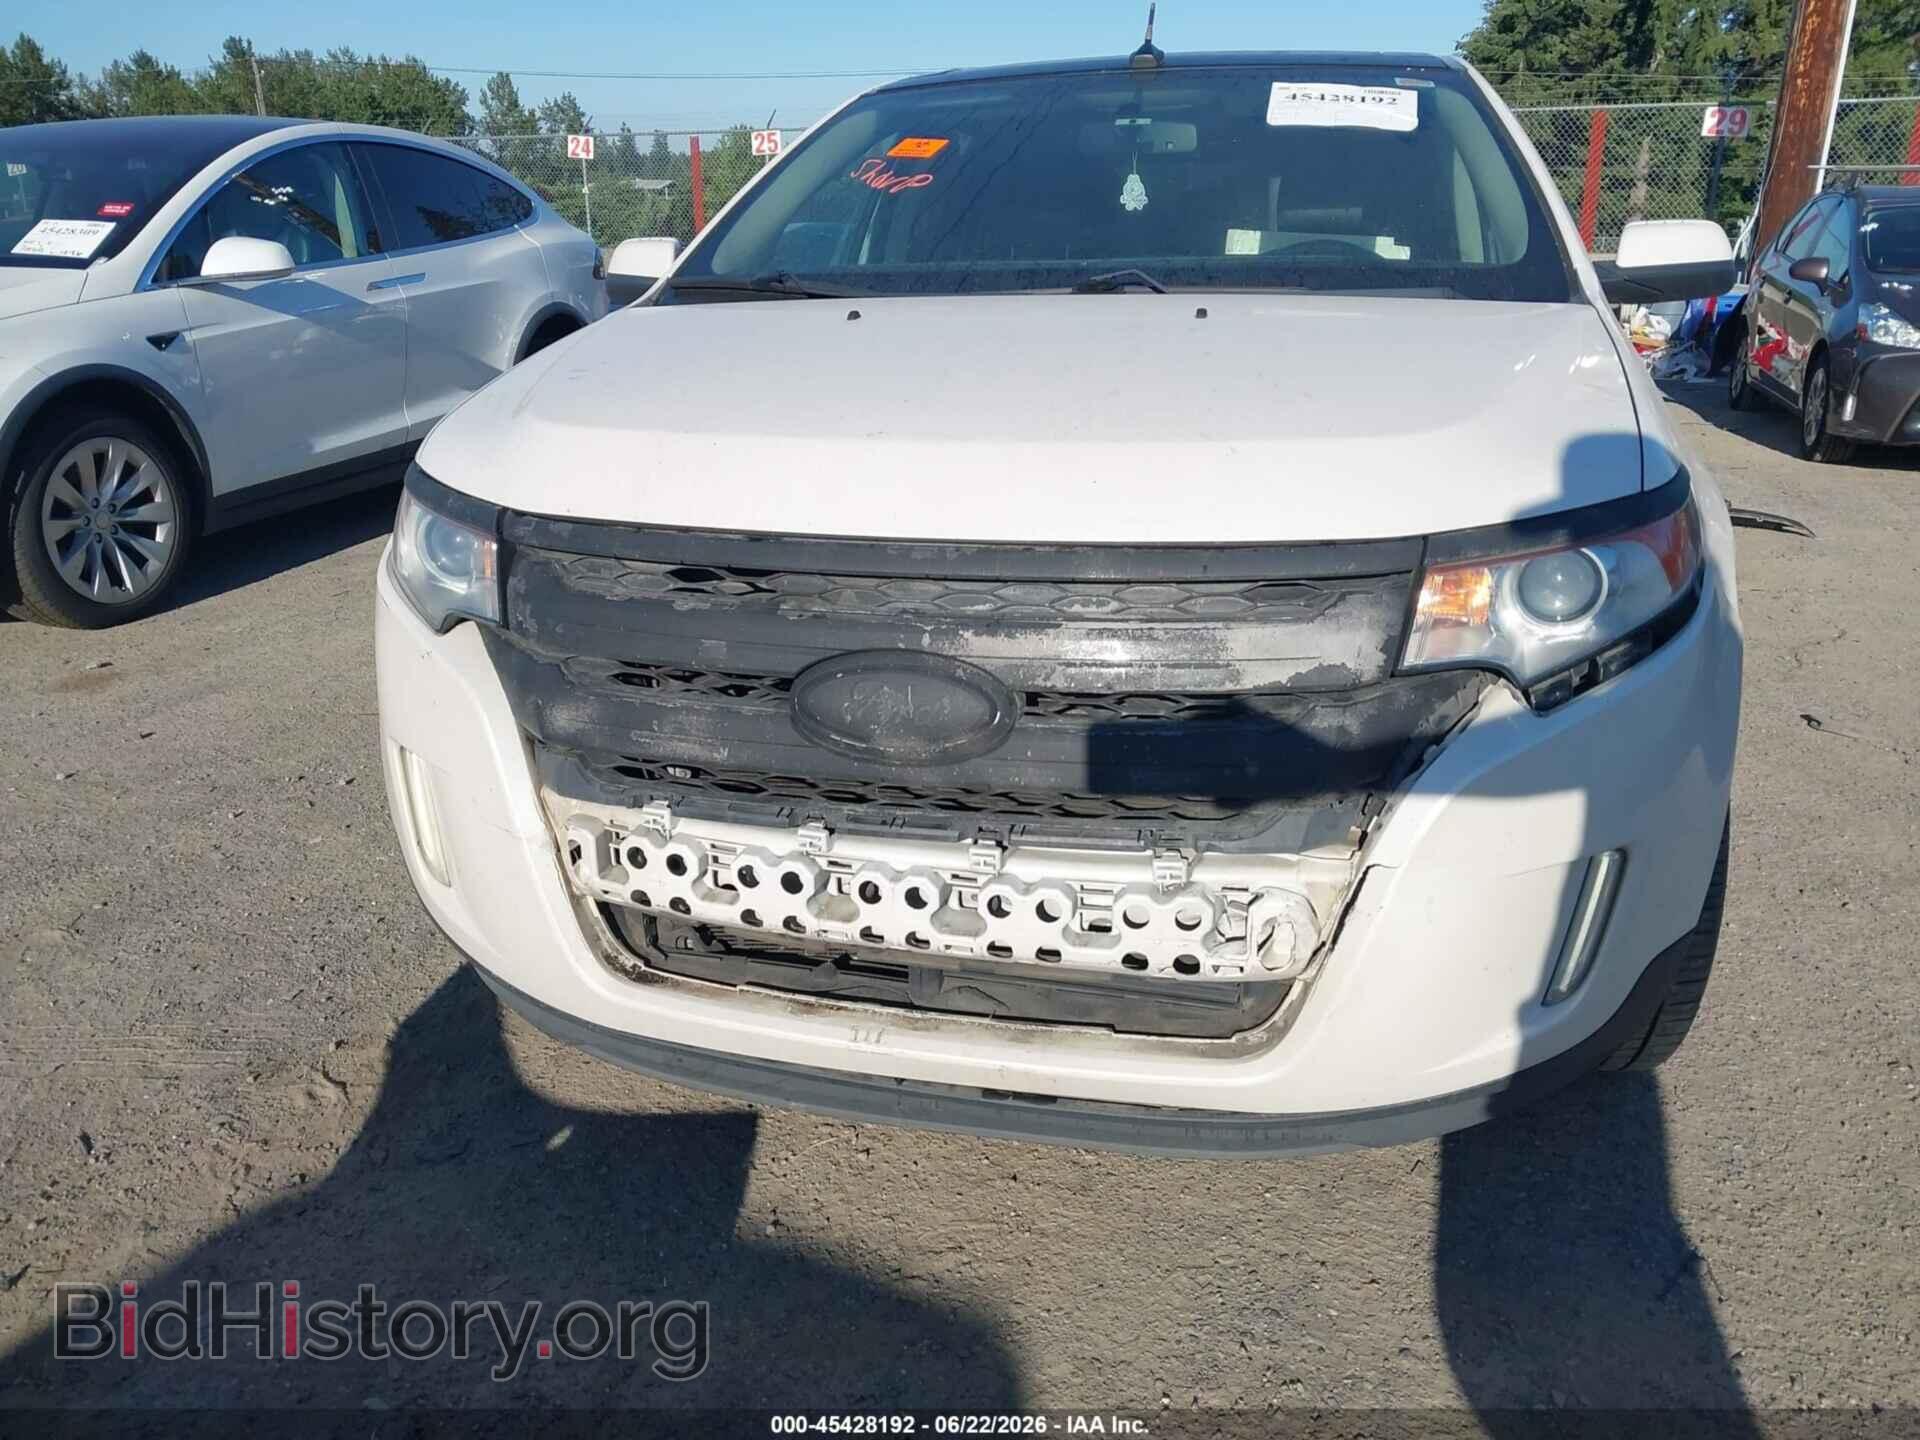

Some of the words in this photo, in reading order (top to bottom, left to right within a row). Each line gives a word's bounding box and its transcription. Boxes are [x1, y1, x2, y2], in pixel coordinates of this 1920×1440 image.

[1285, 92, 1399, 106] 45428192
[1707, 108, 1748, 136] 29
[570, 136, 592, 158] 24
[753, 132, 779, 154] 25
